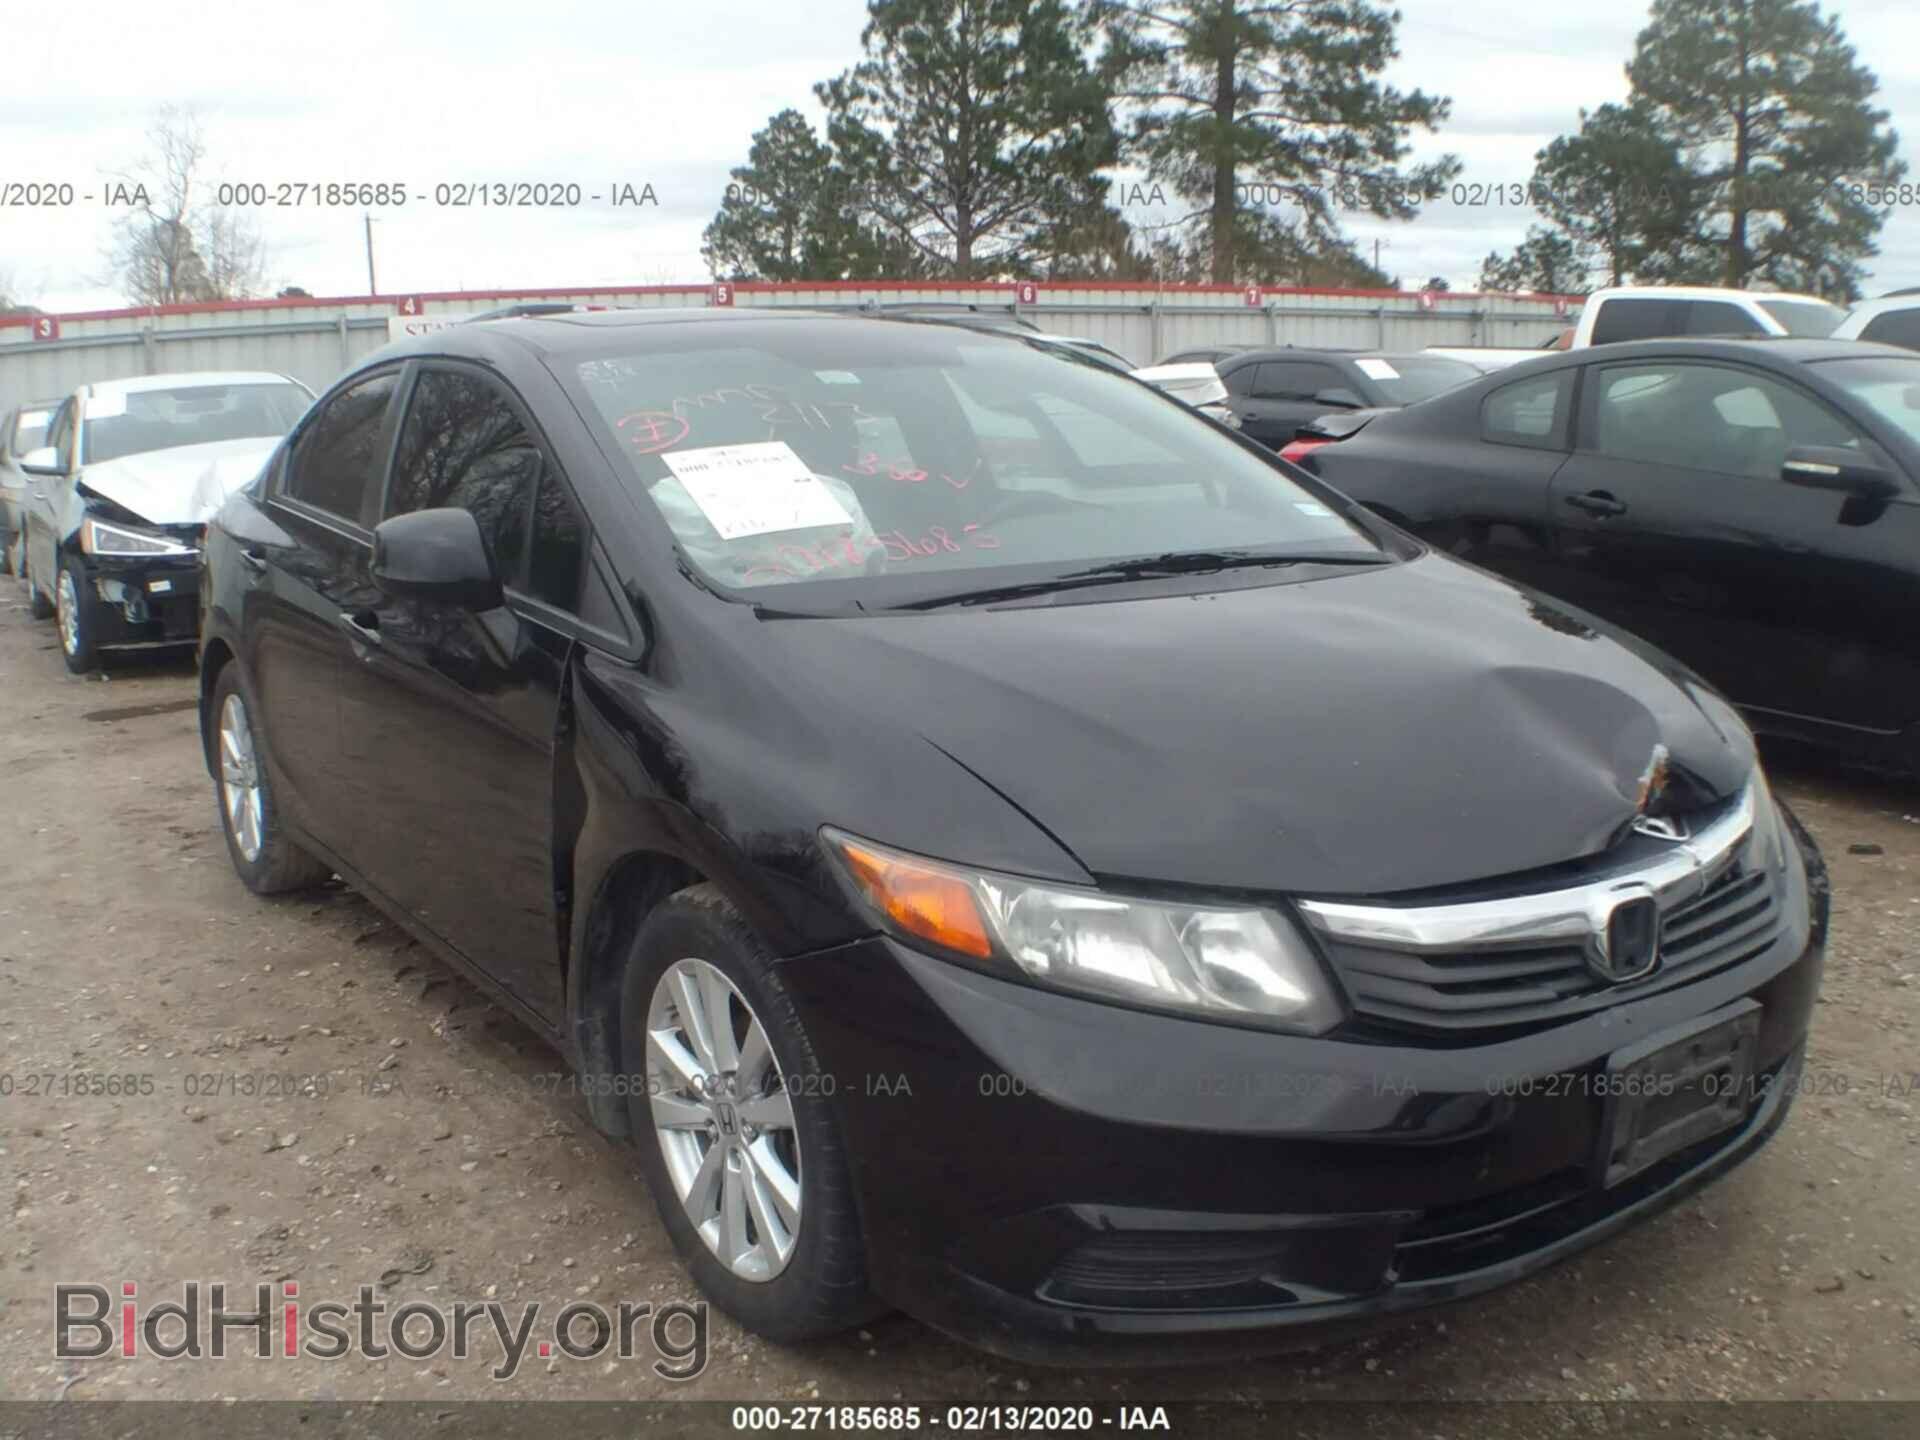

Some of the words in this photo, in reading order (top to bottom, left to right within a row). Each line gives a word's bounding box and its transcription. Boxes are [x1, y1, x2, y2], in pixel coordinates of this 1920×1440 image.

[718, 286, 728, 303] 5
[1249, 290, 1257, 304] 7
[404, 297, 416, 314] 4
[40, 319, 51, 337] 3
